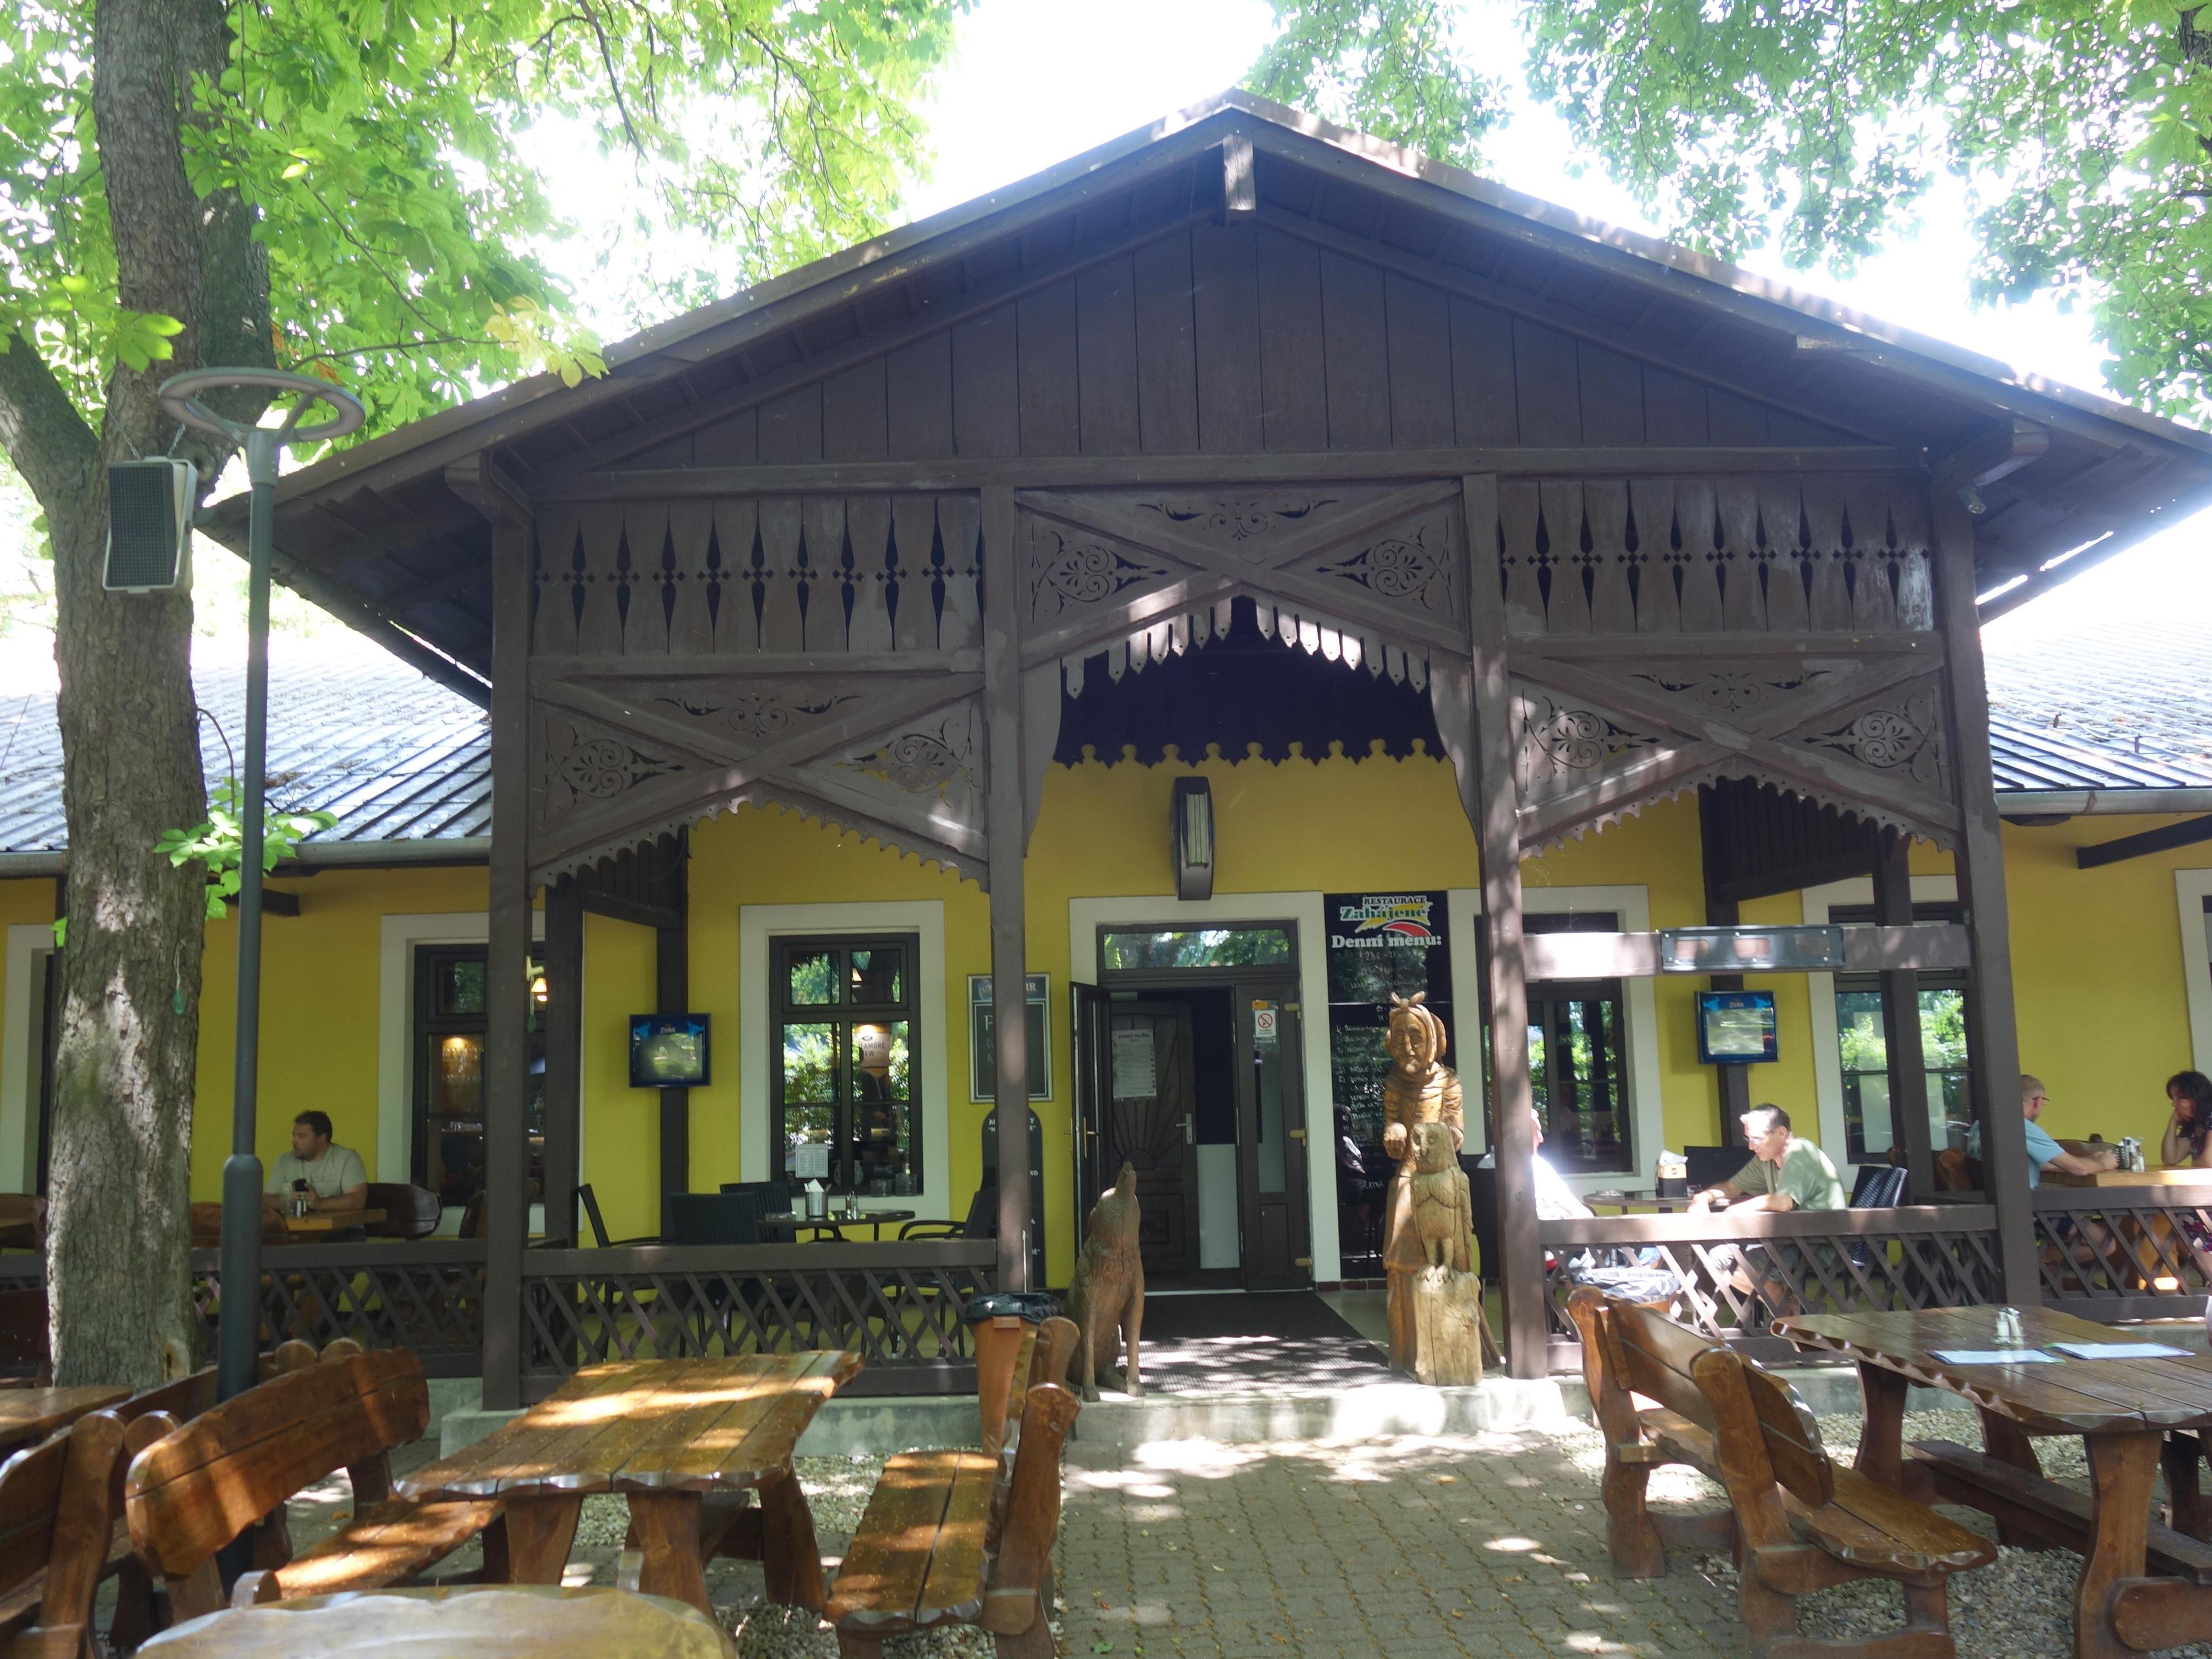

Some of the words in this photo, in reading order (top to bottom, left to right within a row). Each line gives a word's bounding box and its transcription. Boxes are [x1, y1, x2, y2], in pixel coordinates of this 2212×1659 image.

[1363, 896, 1426, 905] RESTAURACE
[1341, 906, 1427, 920] Zahájené
[1332, 934, 1384, 948] Denní
[1388, 935, 1442, 947] menu:
